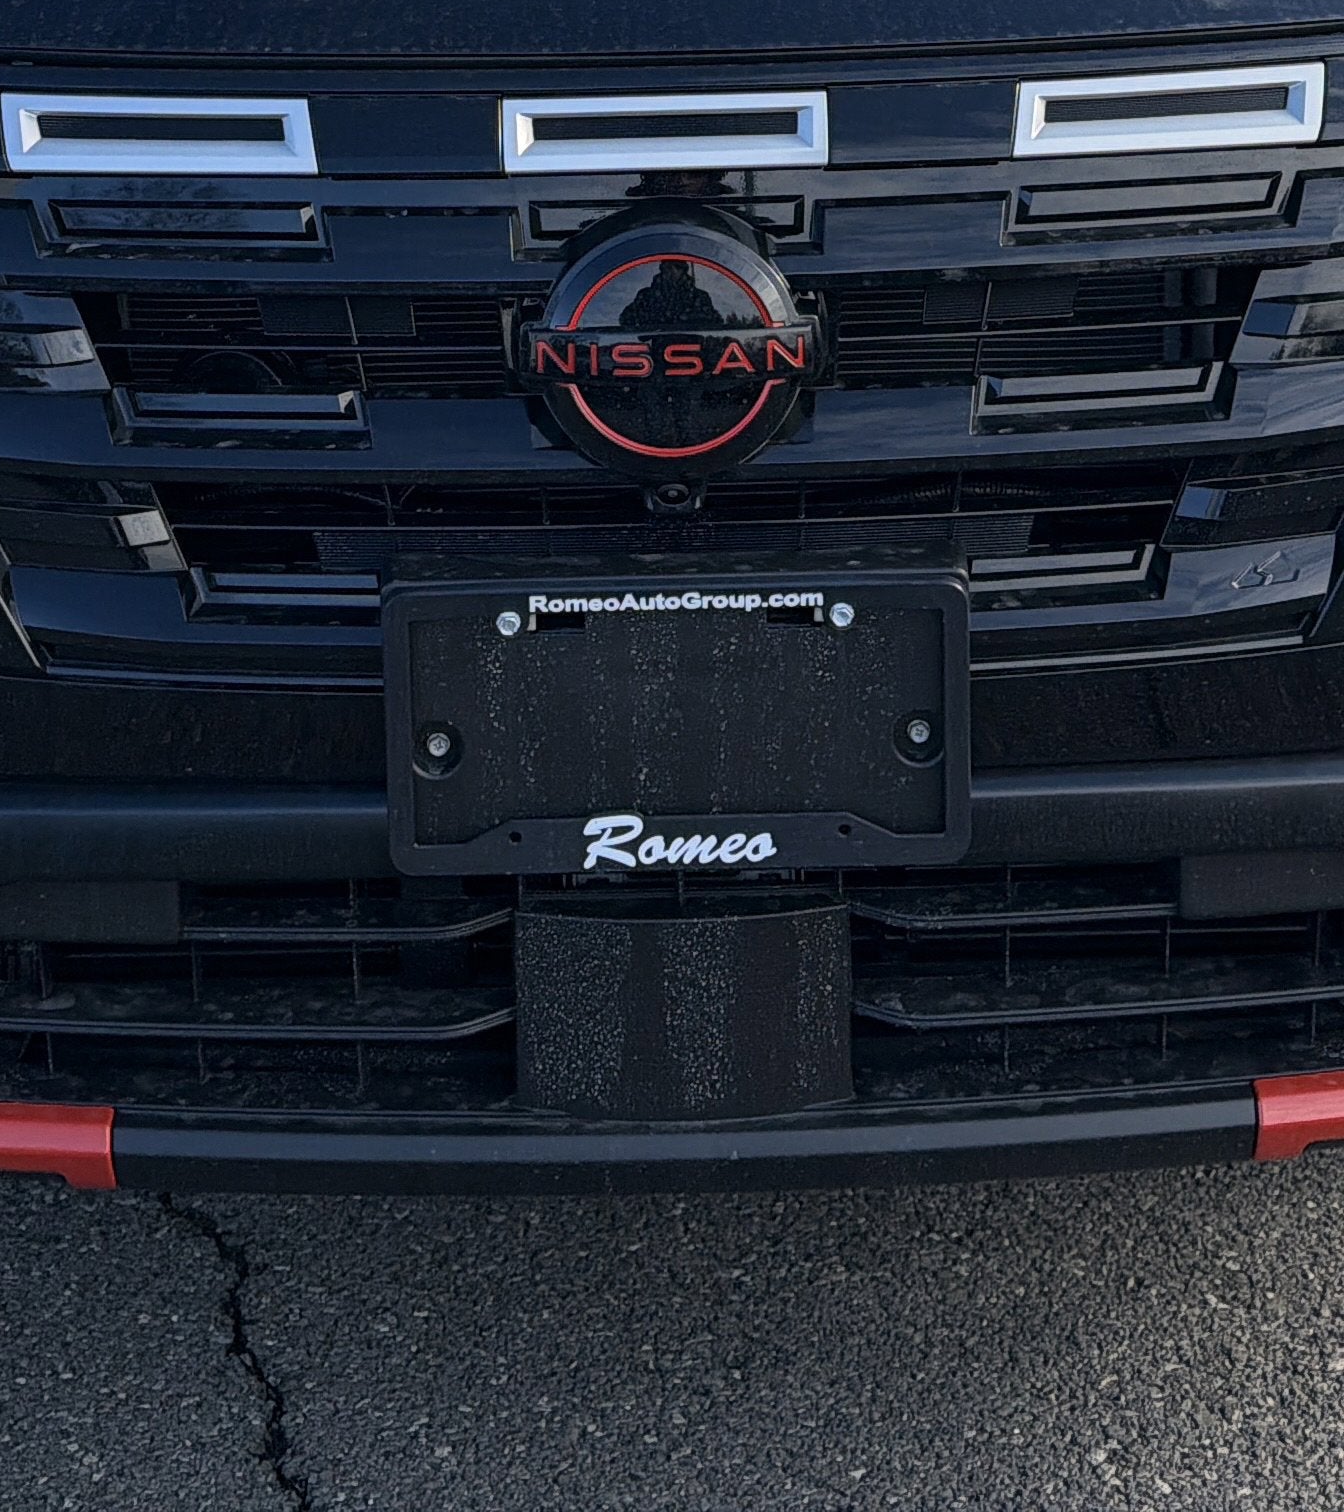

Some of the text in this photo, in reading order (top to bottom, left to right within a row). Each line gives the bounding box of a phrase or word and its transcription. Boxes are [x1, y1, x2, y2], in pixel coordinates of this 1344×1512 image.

[535, 336, 805, 377] NISSAN
[528, 592, 824, 613] RomeoAutoGroup.com
[583, 814, 778, 869] Romeo
